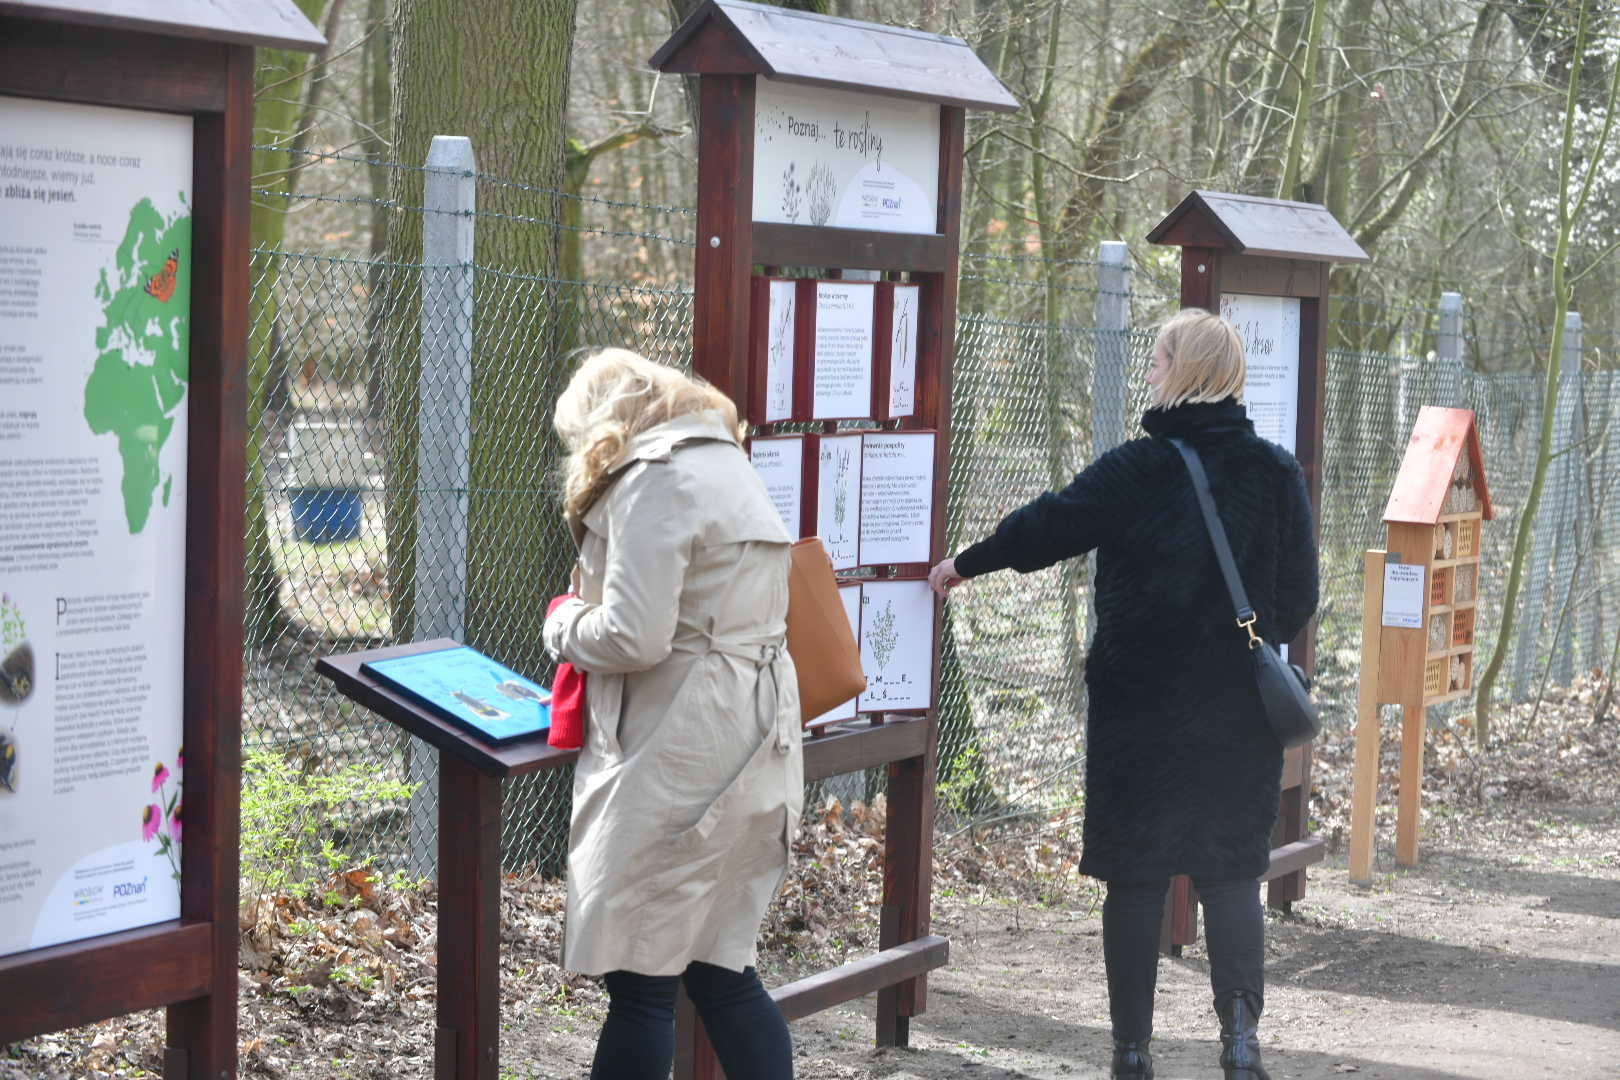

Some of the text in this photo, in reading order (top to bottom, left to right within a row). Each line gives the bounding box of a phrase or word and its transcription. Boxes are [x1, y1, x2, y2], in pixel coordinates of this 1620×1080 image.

[788, 110, 883, 172] Poznaj... te rośliny
[30, 149, 53, 161] coraz
[90, 153, 95, 165] a
[97, 154, 117, 167] noce
[119, 156, 141, 168] coraz
[51, 169, 79, 187] wiemy
[5, 184, 77, 204] zbliża się jesień.
